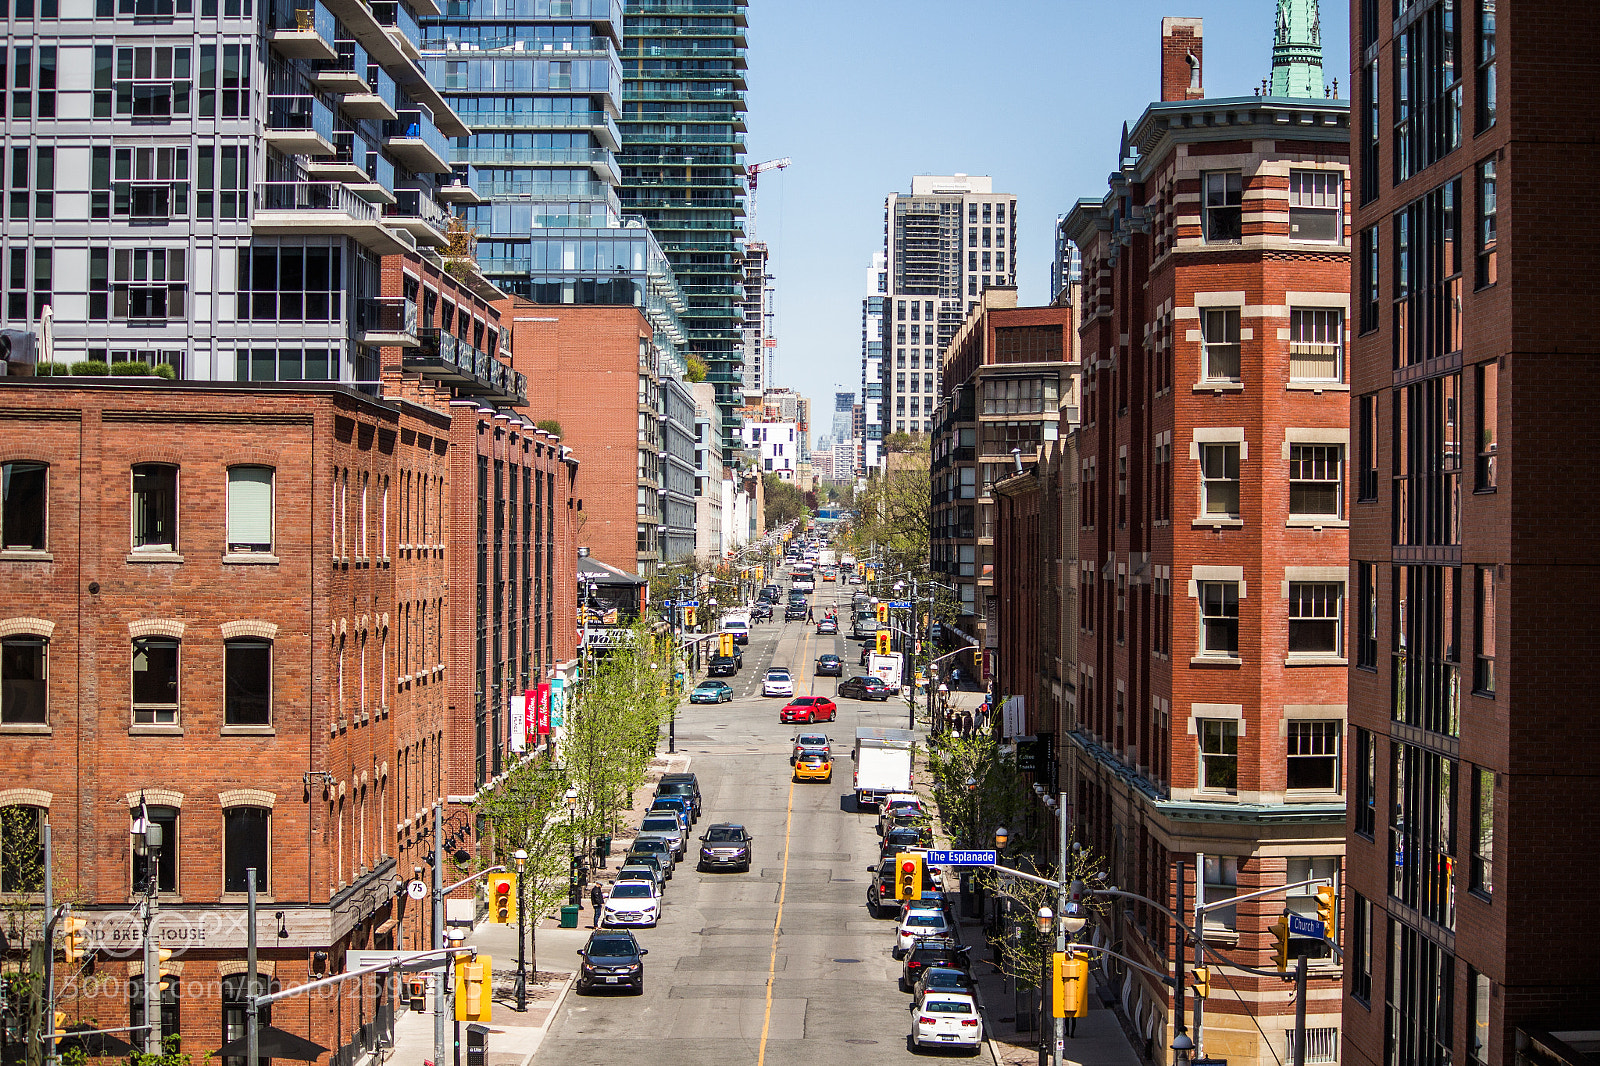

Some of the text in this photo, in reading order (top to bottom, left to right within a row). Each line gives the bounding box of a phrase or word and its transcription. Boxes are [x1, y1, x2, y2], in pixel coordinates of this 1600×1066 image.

[988, 599, 996, 619] LEASE
[539, 714, 548, 727] Tim
[929, 851, 994, 864] The Esplanade
[412, 883, 423, 893] 75
[1294, 917, 1315, 933] Church
[113, 929, 206, 941] BREHOUSE
